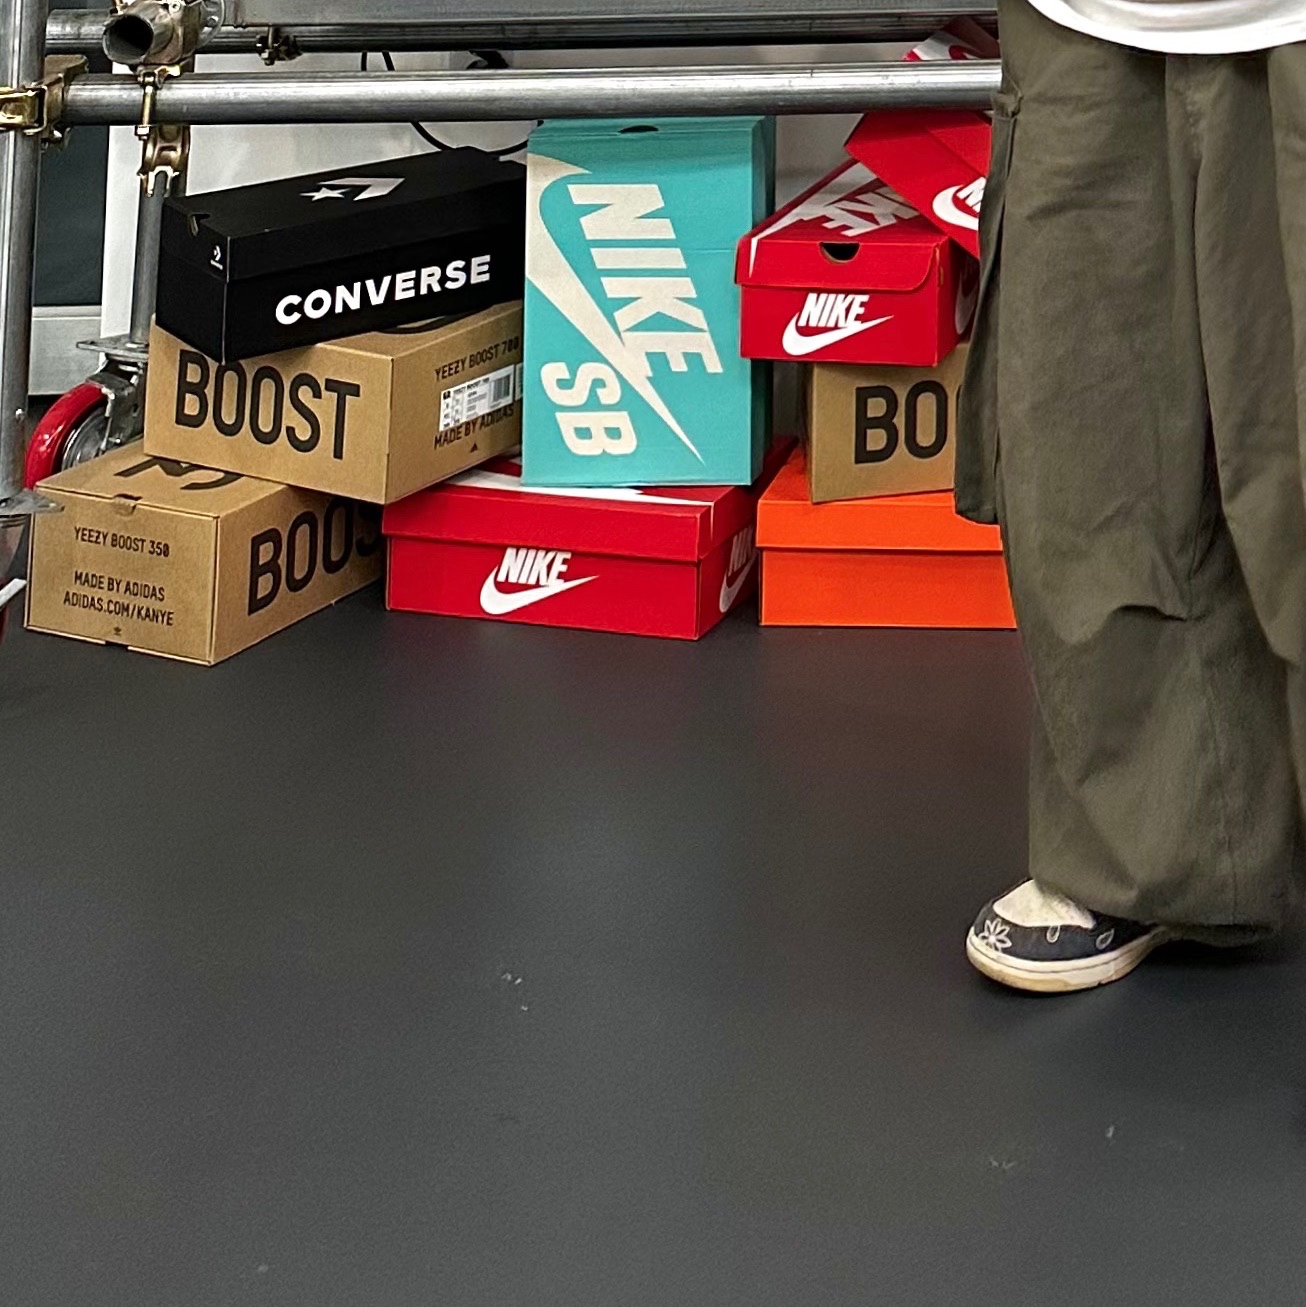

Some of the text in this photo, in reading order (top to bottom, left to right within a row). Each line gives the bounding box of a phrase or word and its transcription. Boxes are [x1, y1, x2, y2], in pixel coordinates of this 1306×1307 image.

[275, 254, 492, 325] CONVERSE
[567, 183, 724, 378] NIKE
[798, 292, 870, 329] NIKE
[435, 357, 467, 381] YEEZY
[468, 343, 500, 369] BOOST
[175, 349, 362, 461] BOOST
[540, 361, 638, 457] SB
[434, 425, 462, 450] MADE
[464, 419, 478, 437] BY
[74, 526, 109, 546] YEEZY
[111, 533, 146, 554] BOOST
[497, 546, 572, 586] NIKE
[74, 570, 165, 602] MADE BY ADIDAS
[63, 590, 175, 626] ADIDAS.COM/KANYE
